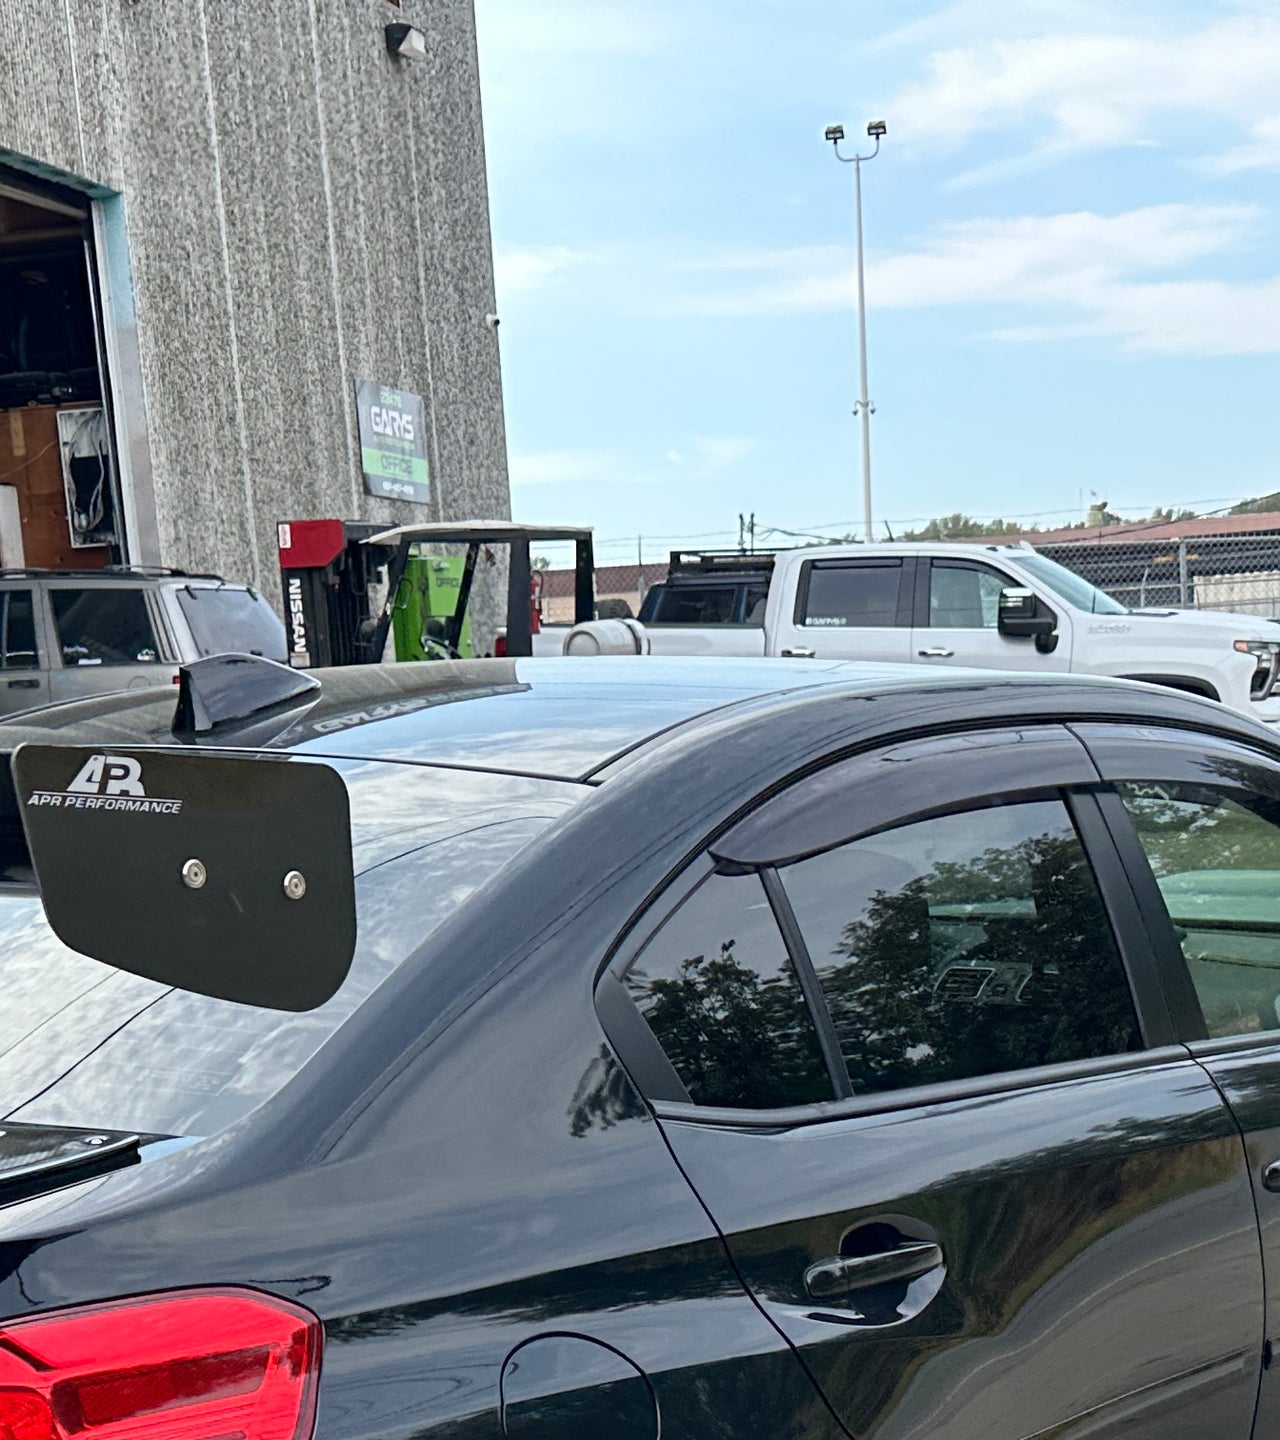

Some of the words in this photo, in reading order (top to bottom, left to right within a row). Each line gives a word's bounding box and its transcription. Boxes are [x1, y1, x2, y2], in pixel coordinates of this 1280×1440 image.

[288, 578, 307, 653] NISSAN
[27, 793, 61, 808] APR
[64, 797, 182, 814] PERFORMANCE
